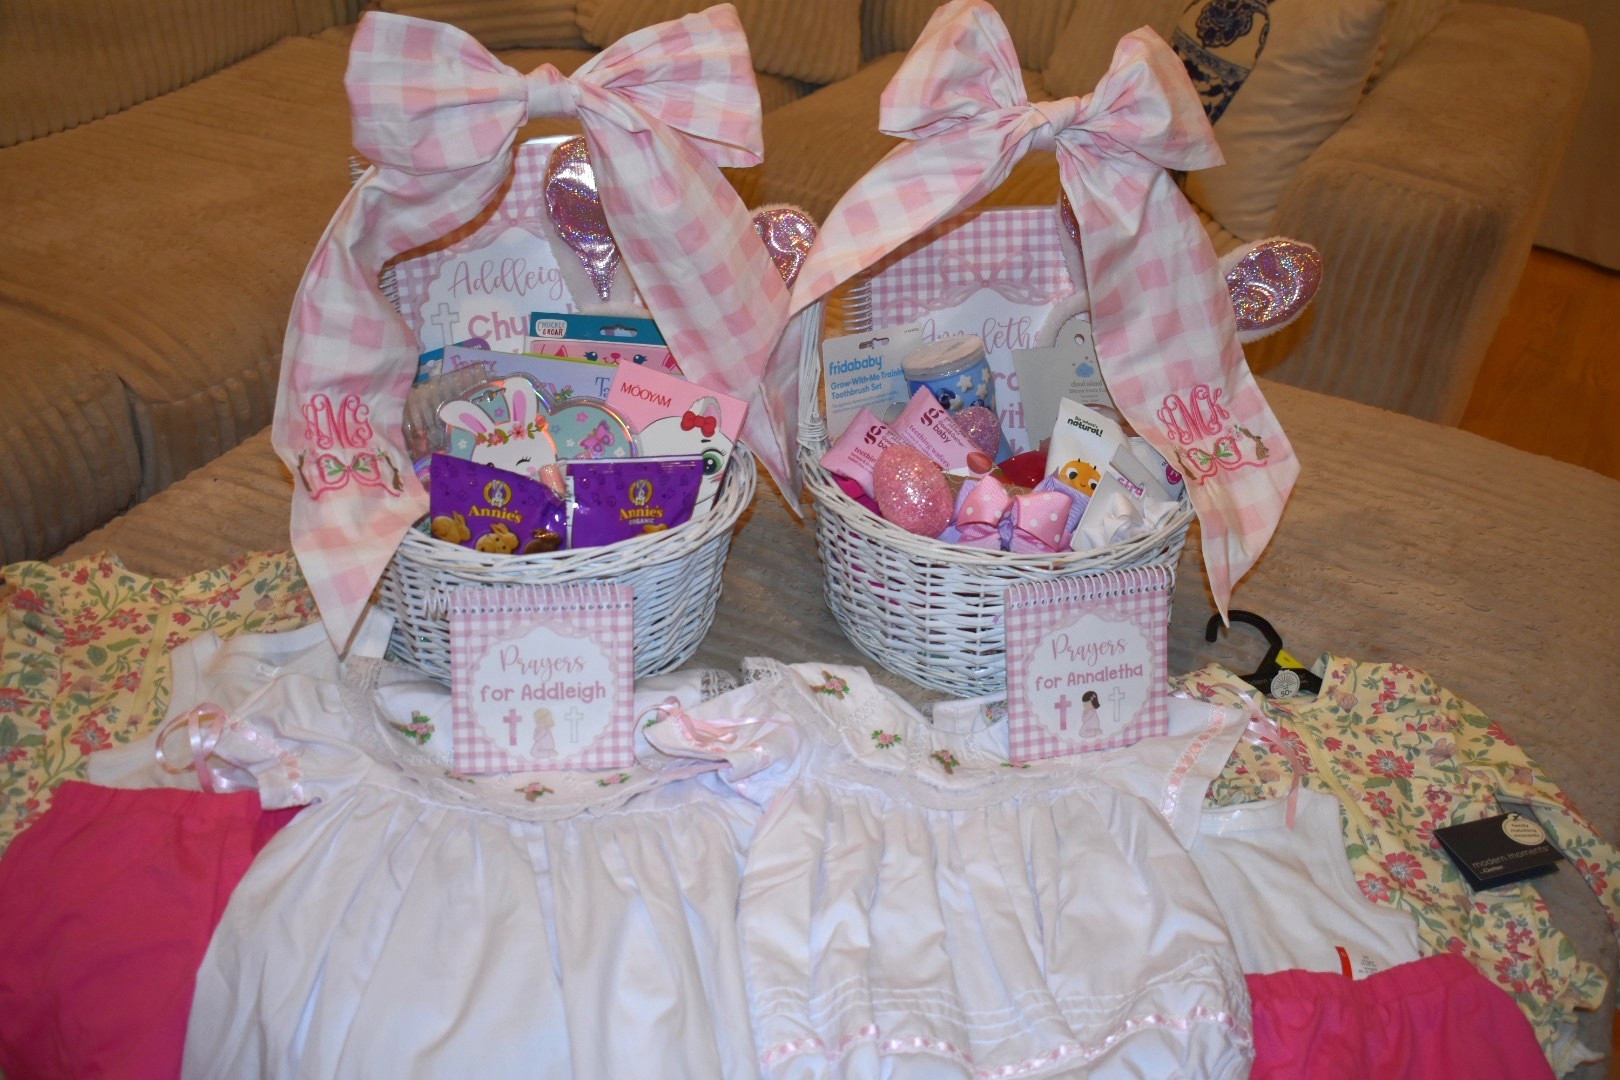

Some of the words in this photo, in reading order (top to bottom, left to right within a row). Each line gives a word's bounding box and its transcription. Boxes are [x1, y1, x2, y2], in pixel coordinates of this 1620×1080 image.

[448, 257, 563, 300] Addleig
[829, 355, 882, 376] fridababy
[831, 373, 880, 390] Grow-With-Me
[832, 386, 870, 400] Toothbrush
[871, 383, 882, 391] Set
[932, 424, 952, 444] baby
[1067, 418, 1104, 438] natural!
[854, 446, 877, 464] teethin
[468, 504, 523, 524] Annie's
[620, 504, 663, 521] Annie's
[1051, 633, 1128, 667] Prayers
[500, 644, 586, 682] Prayers
[1035, 676, 1063, 691] for
[1067, 663, 1144, 687] Annaletha
[480, 684, 515, 703] for
[521, 680, 606, 704] Addleigh
[1472, 855, 1508, 869] modern
